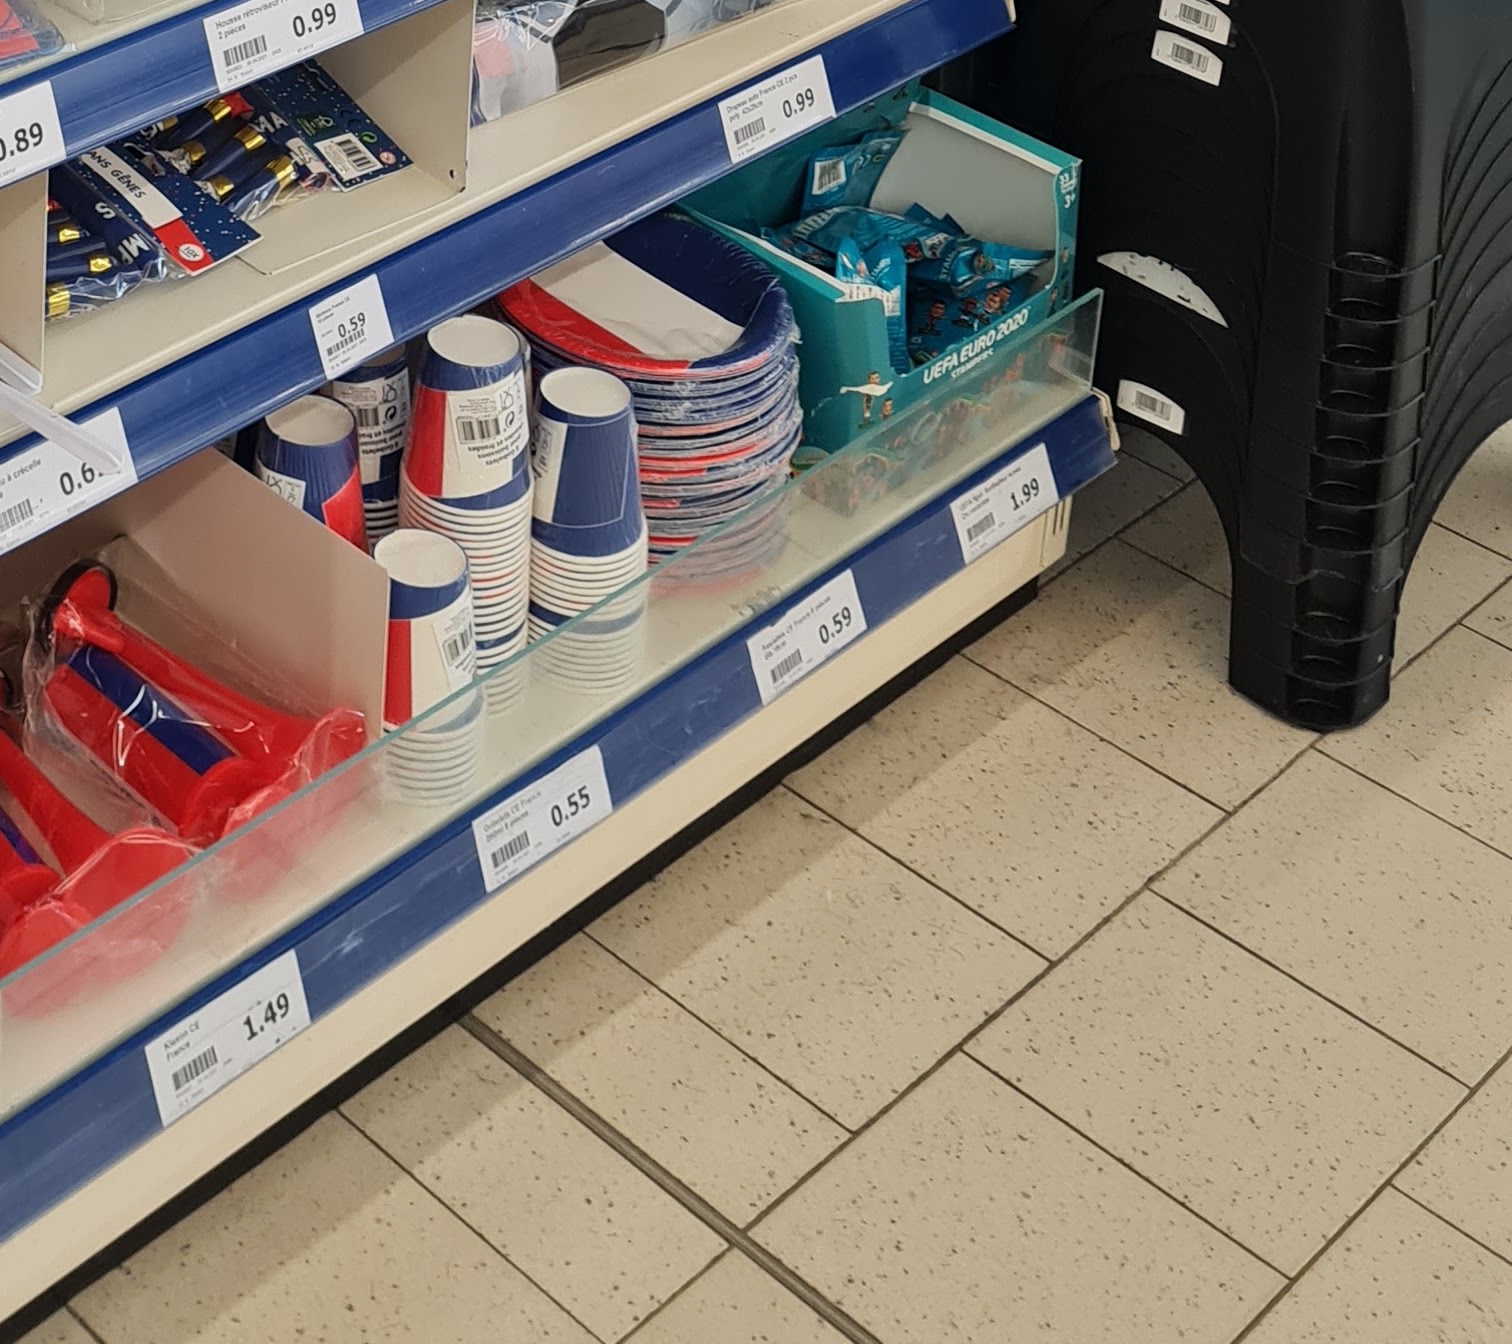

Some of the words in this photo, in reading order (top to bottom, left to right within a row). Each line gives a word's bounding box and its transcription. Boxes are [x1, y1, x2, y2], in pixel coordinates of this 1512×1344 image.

[215, 14, 242, 30] Housse
[217, 31, 223, 40] 2
[224, 23, 246, 39] pièces
[292, 2, 336, 38] 0.99
[782, 88, 815, 119] 0.99
[110, 166, 147, 200] GÊNES
[338, 312, 366, 338] 0.59
[923, 352, 959, 384] UEFA
[960, 329, 996, 363] EURO
[996, 307, 1029, 341] 2020
[7, 474, 12, 483] à
[13, 458, 42, 480] crécelle
[59, 462, 106, 496] 0.6
[1010, 478, 1039, 511] 1.99
[819, 606, 851, 644] 0.59
[551, 784, 591, 827] 0.55
[243, 992, 289, 1042] 1.49
